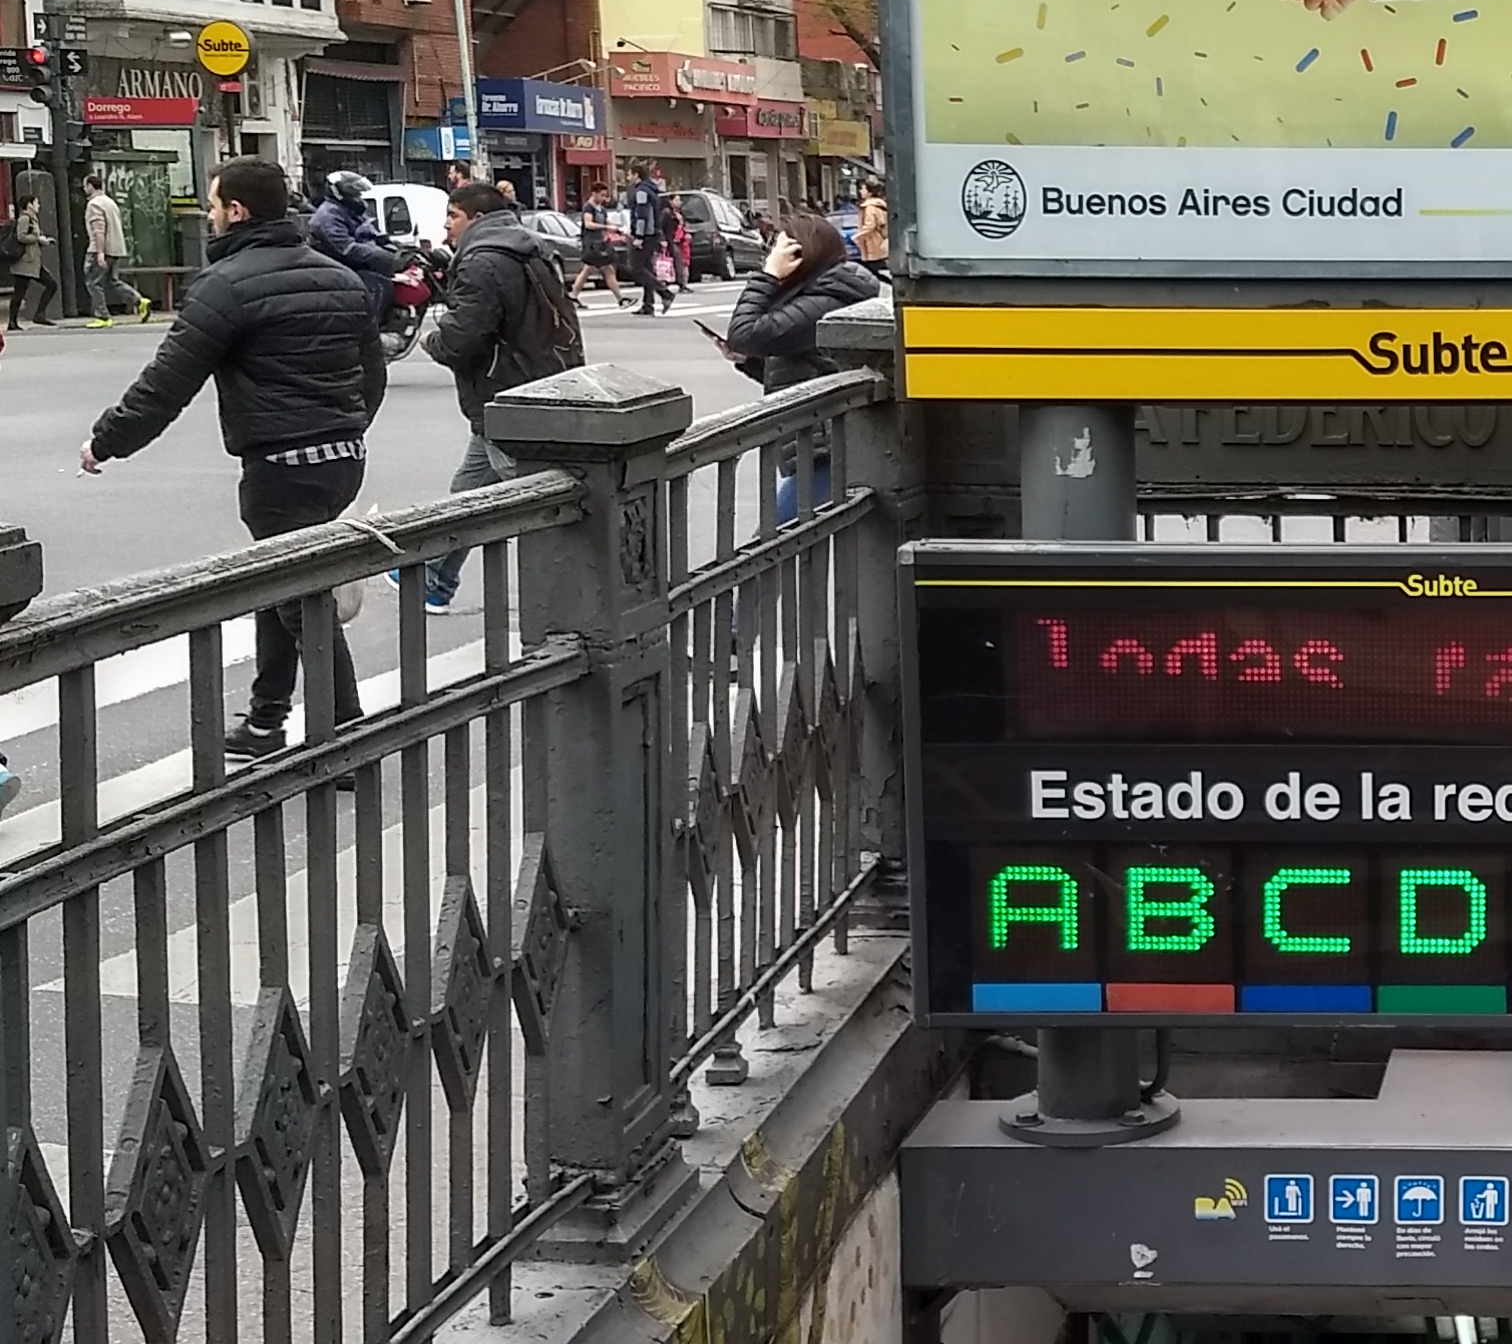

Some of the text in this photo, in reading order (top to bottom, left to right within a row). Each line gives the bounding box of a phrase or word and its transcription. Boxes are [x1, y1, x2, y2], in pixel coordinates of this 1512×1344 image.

[204, 39, 242, 52] Subte
[87, 102, 131, 114] Dorrego
[1043, 187, 1402, 216] Buenos Aires Ciudad
[1366, 332, 1508, 376] Subte
[1407, 574, 1477, 598] Subte
[1031, 771, 1243, 819] Estado
[1265, 772, 1340, 820] de
[1362, 773, 1411, 820] la
[989, 867, 1079, 956] A
[1125, 867, 1215, 956] B
[1263, 867, 1351, 956] C
[1400, 867, 1486, 956] D
